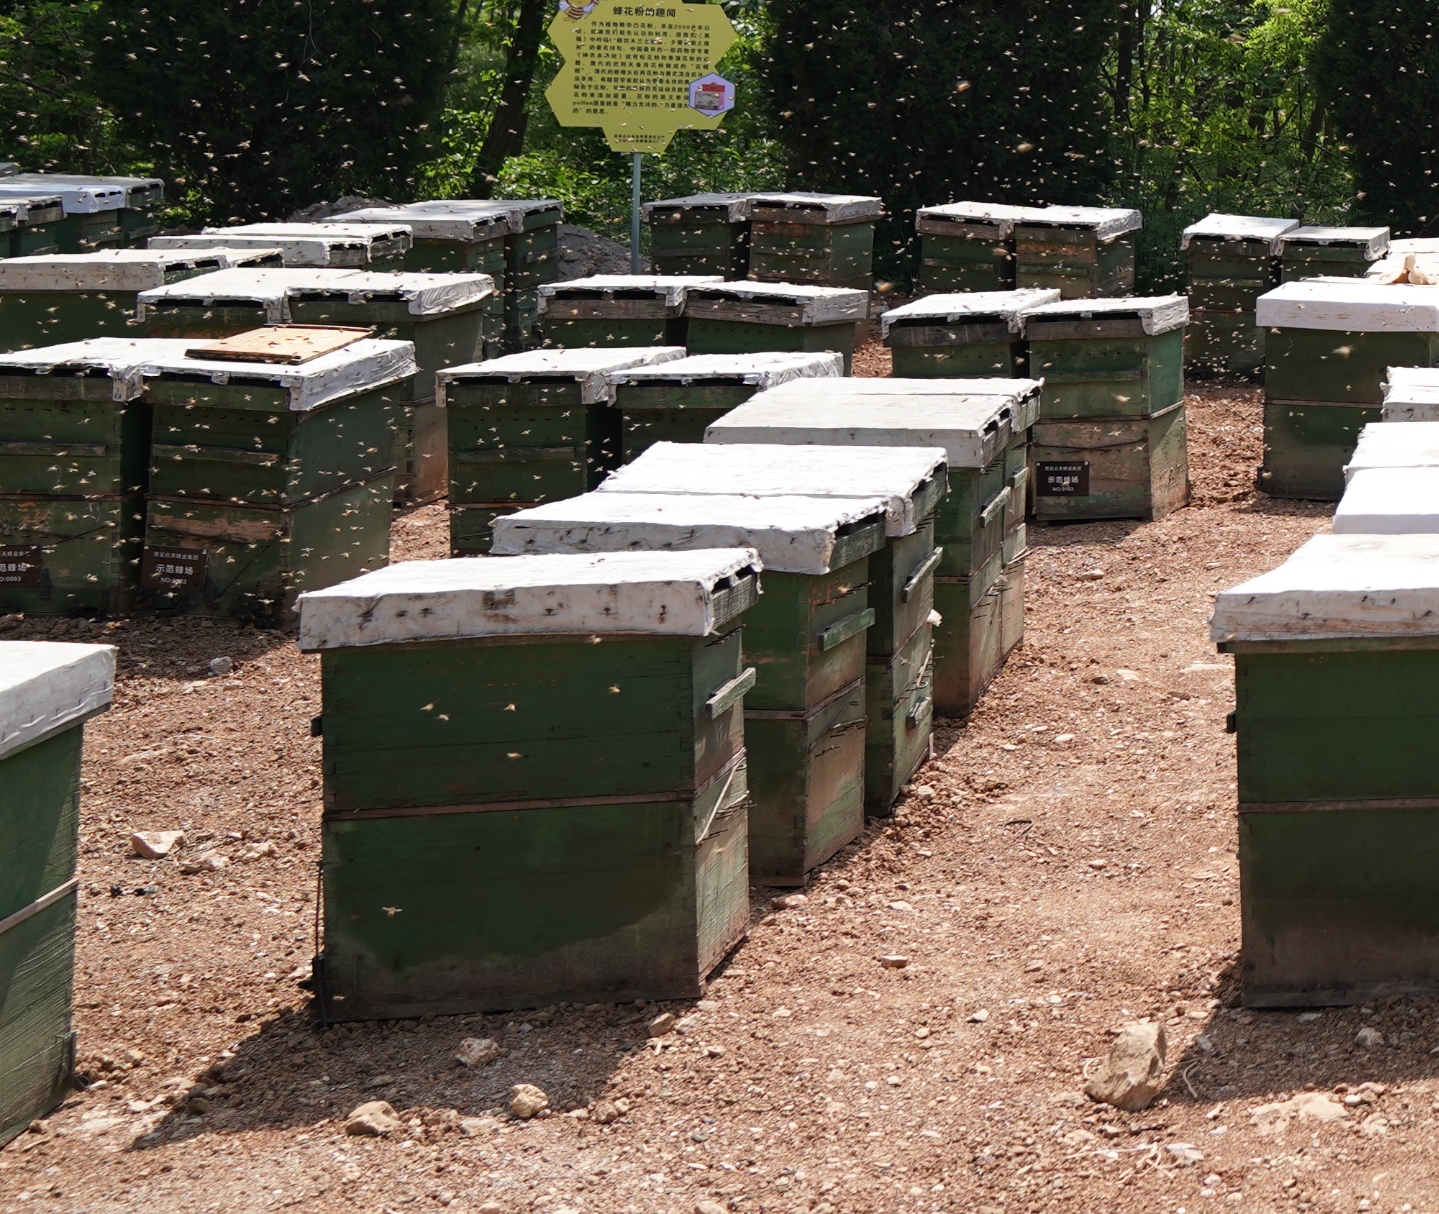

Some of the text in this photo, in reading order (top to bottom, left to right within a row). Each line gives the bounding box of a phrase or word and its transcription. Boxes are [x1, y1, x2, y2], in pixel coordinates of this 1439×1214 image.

[613, 6, 676, 17] 蜂花粉的趣闻
[153, 551, 199, 561] 西安众天蜂业集团
[155, 563, 194, 576] 示范蜂场
